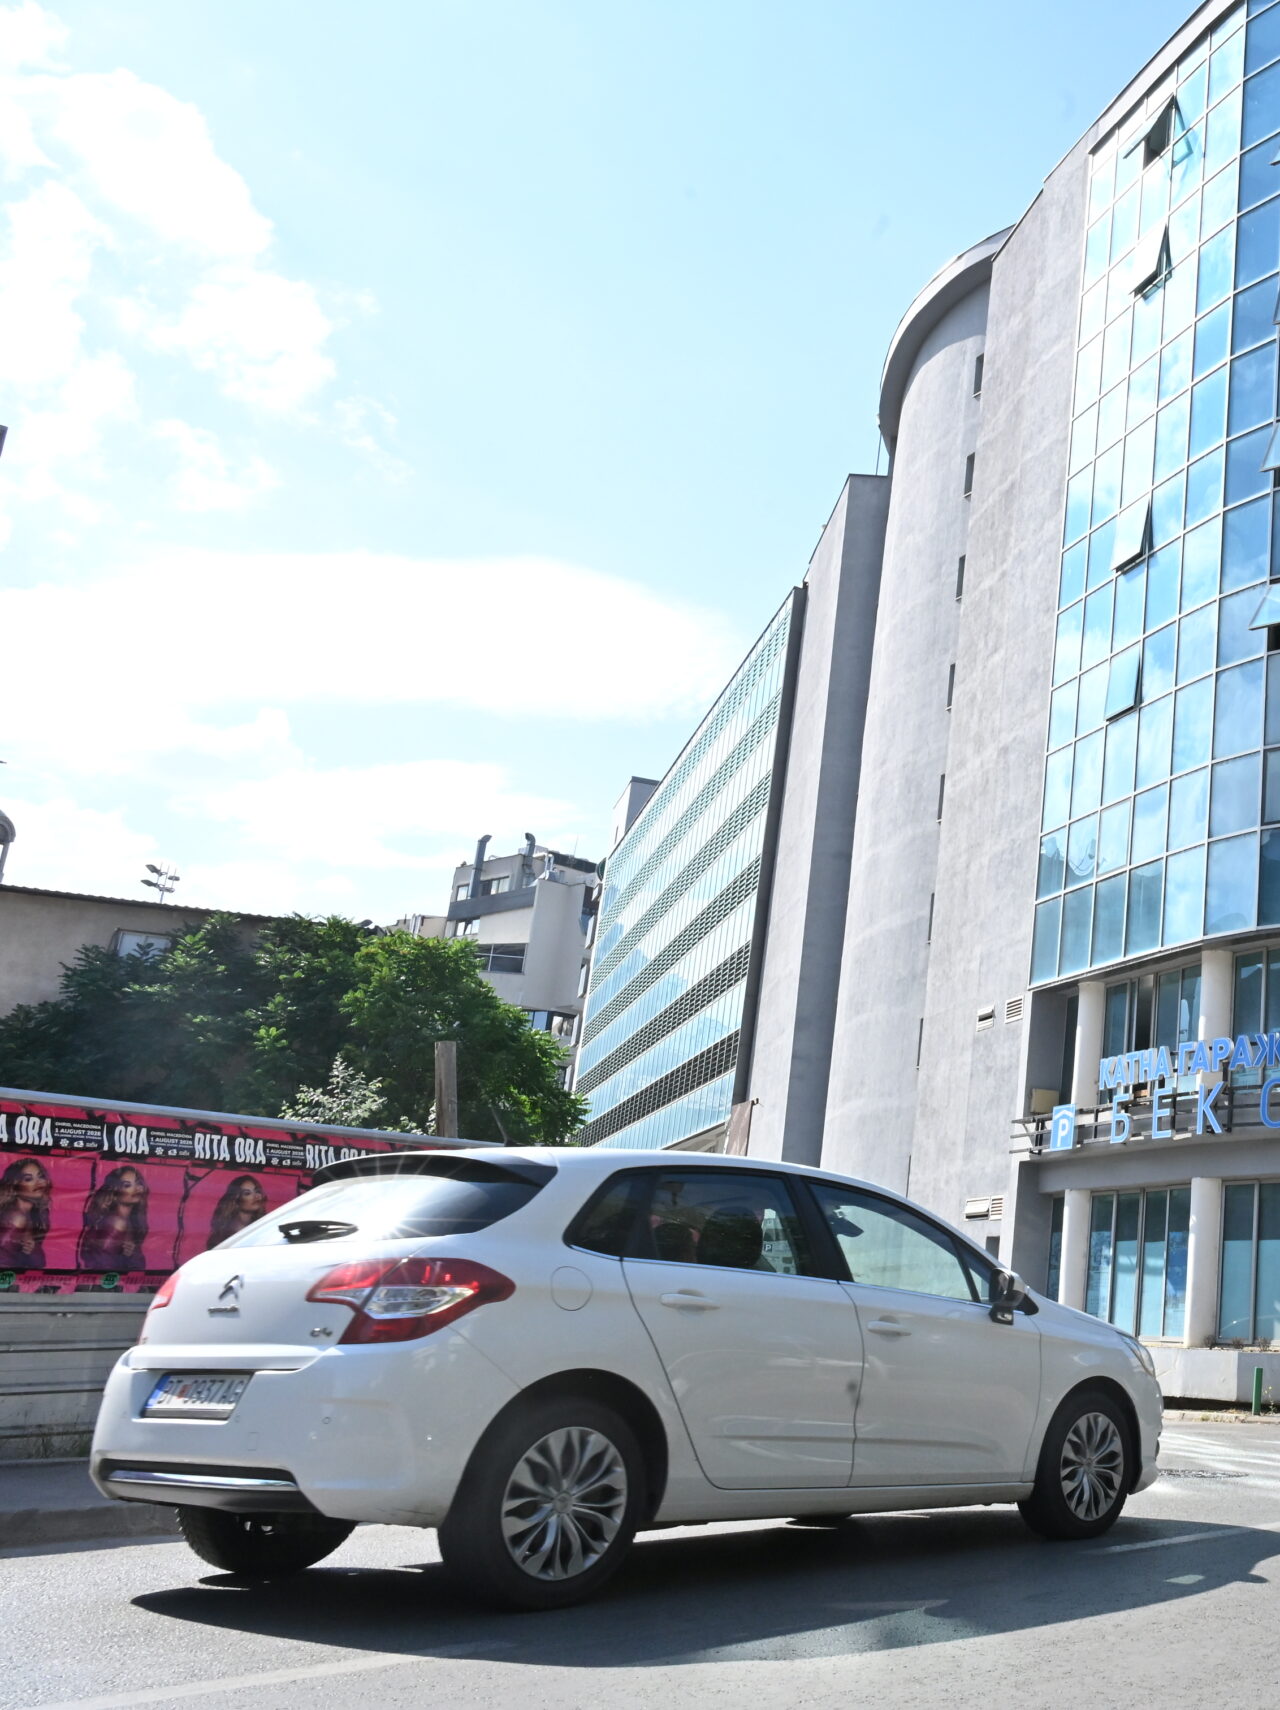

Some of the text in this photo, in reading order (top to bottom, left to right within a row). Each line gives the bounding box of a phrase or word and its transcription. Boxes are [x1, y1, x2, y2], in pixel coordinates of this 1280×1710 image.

[1099, 1046, 1172, 1091] КАТНА
[15, 1115, 53, 1146] ORA
[114, 1125, 149, 1155] ORA
[1057, 1118, 1069, 1148] P
[194, 1133, 266, 1164] RITA ORA
[305, 1144, 336, 1169] RITA
